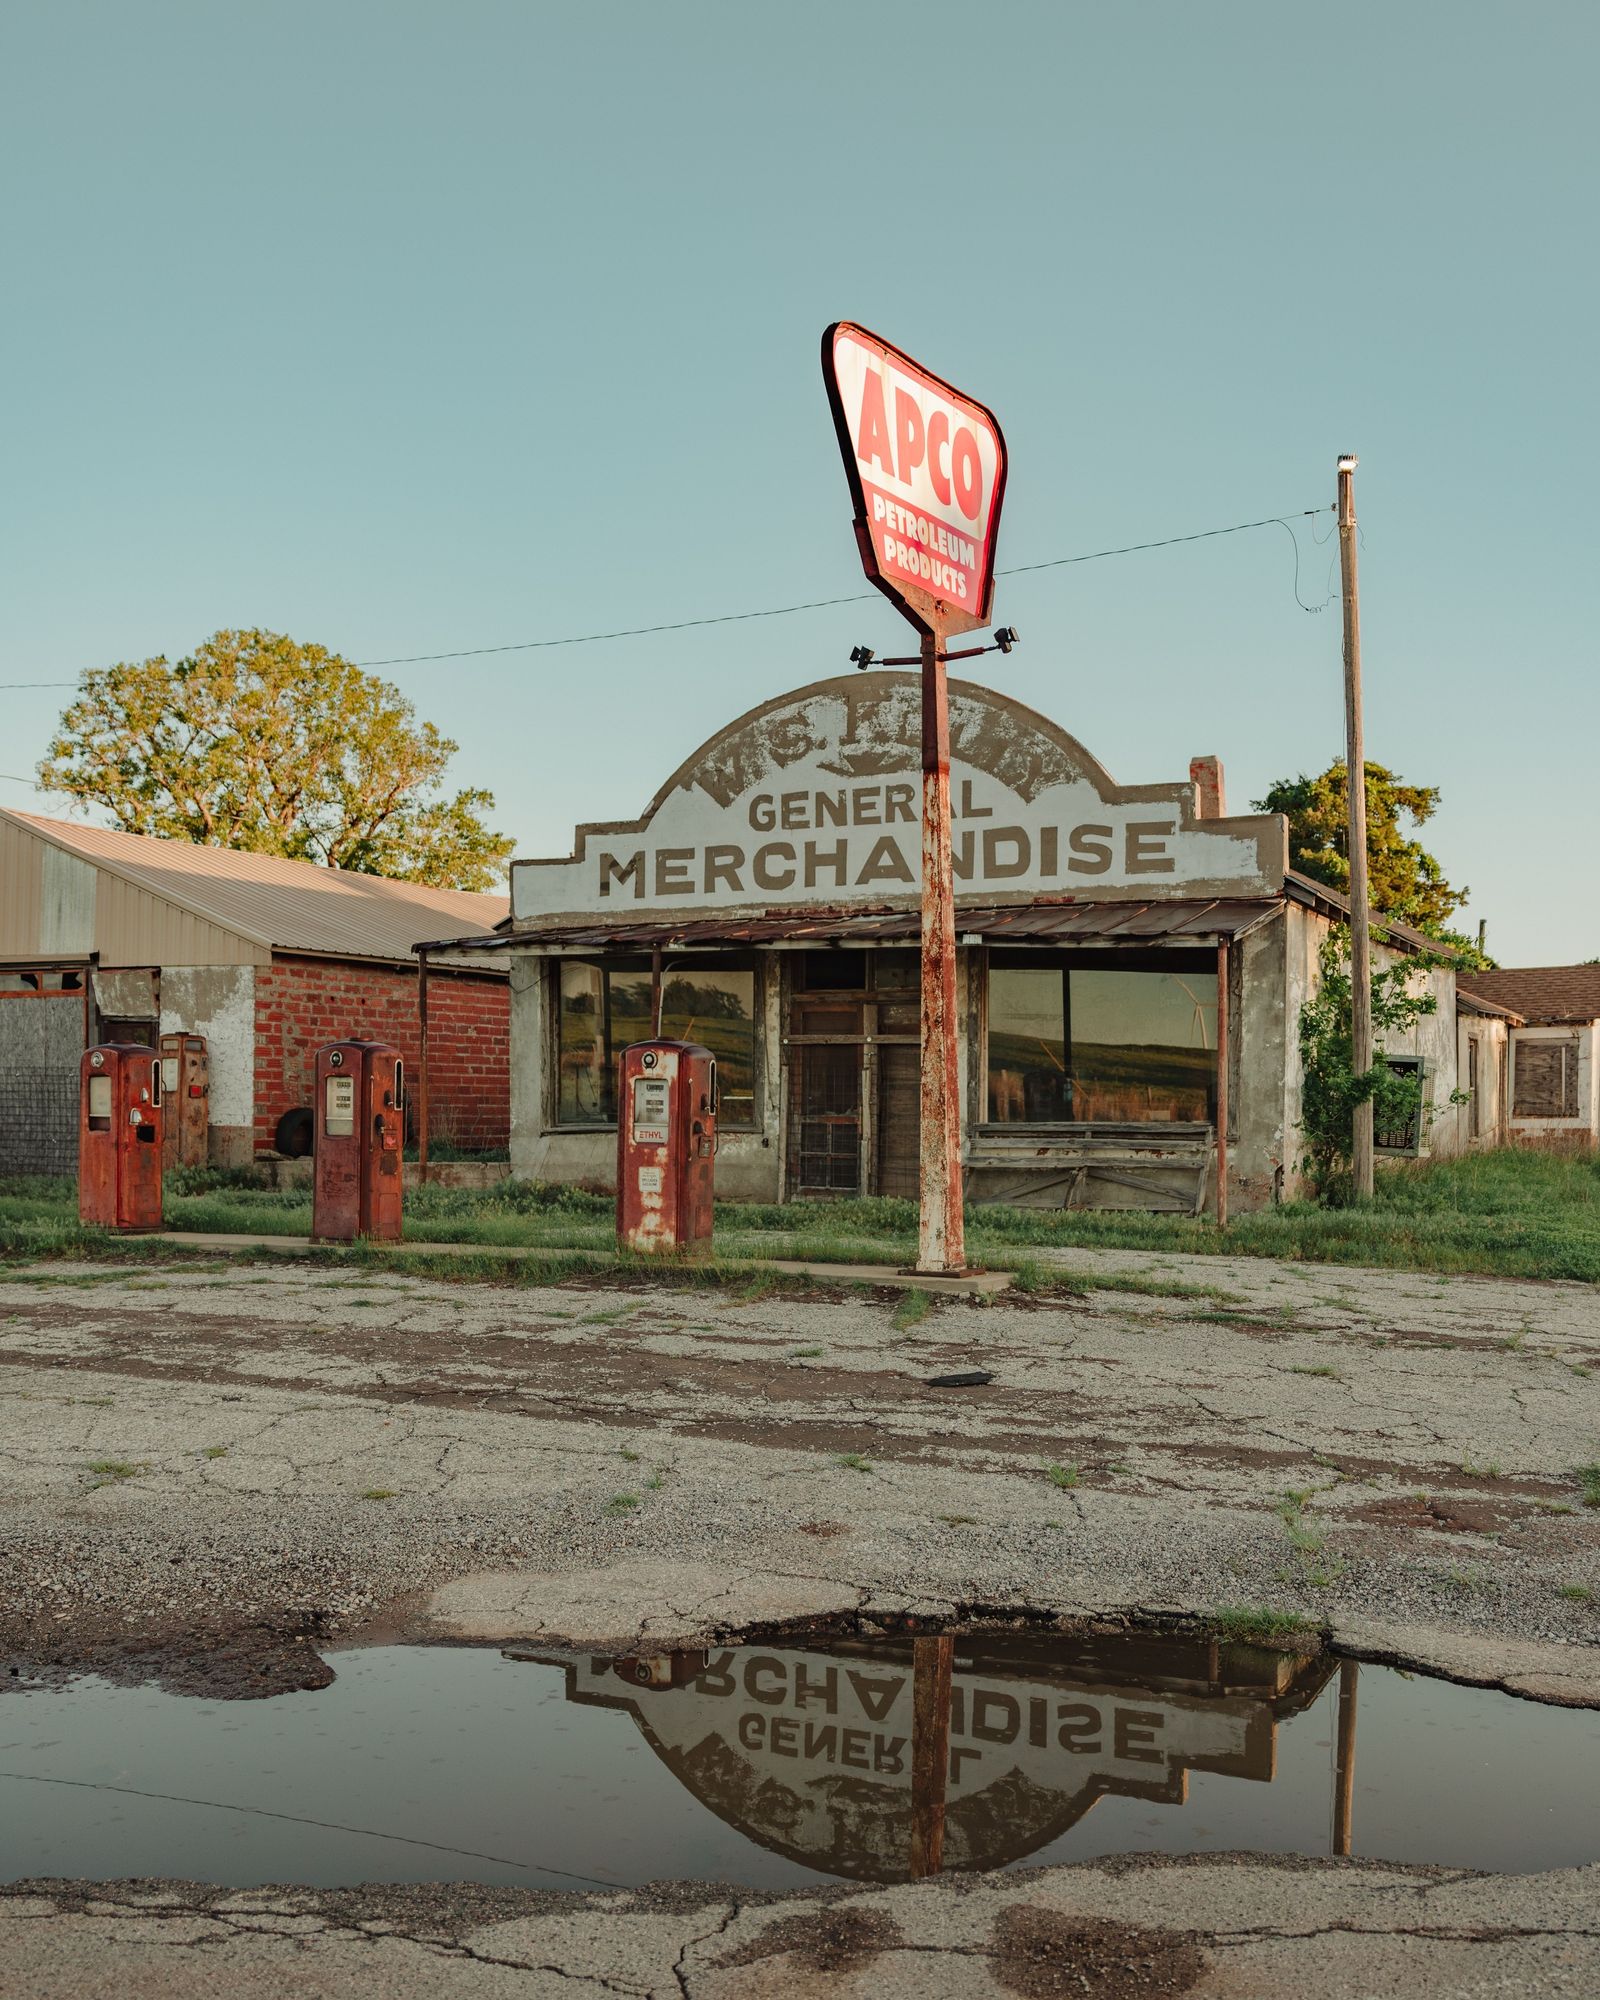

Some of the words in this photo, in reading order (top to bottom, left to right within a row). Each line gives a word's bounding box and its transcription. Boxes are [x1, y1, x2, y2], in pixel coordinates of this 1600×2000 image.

[857, 366, 984, 522] APCO
[872, 492, 976, 571] PETROLEUM
[883, 533, 968, 599] PRODUCTS
[749, 779, 993, 833] GENERL
[639, 1130, 664, 1139] ETHYL
